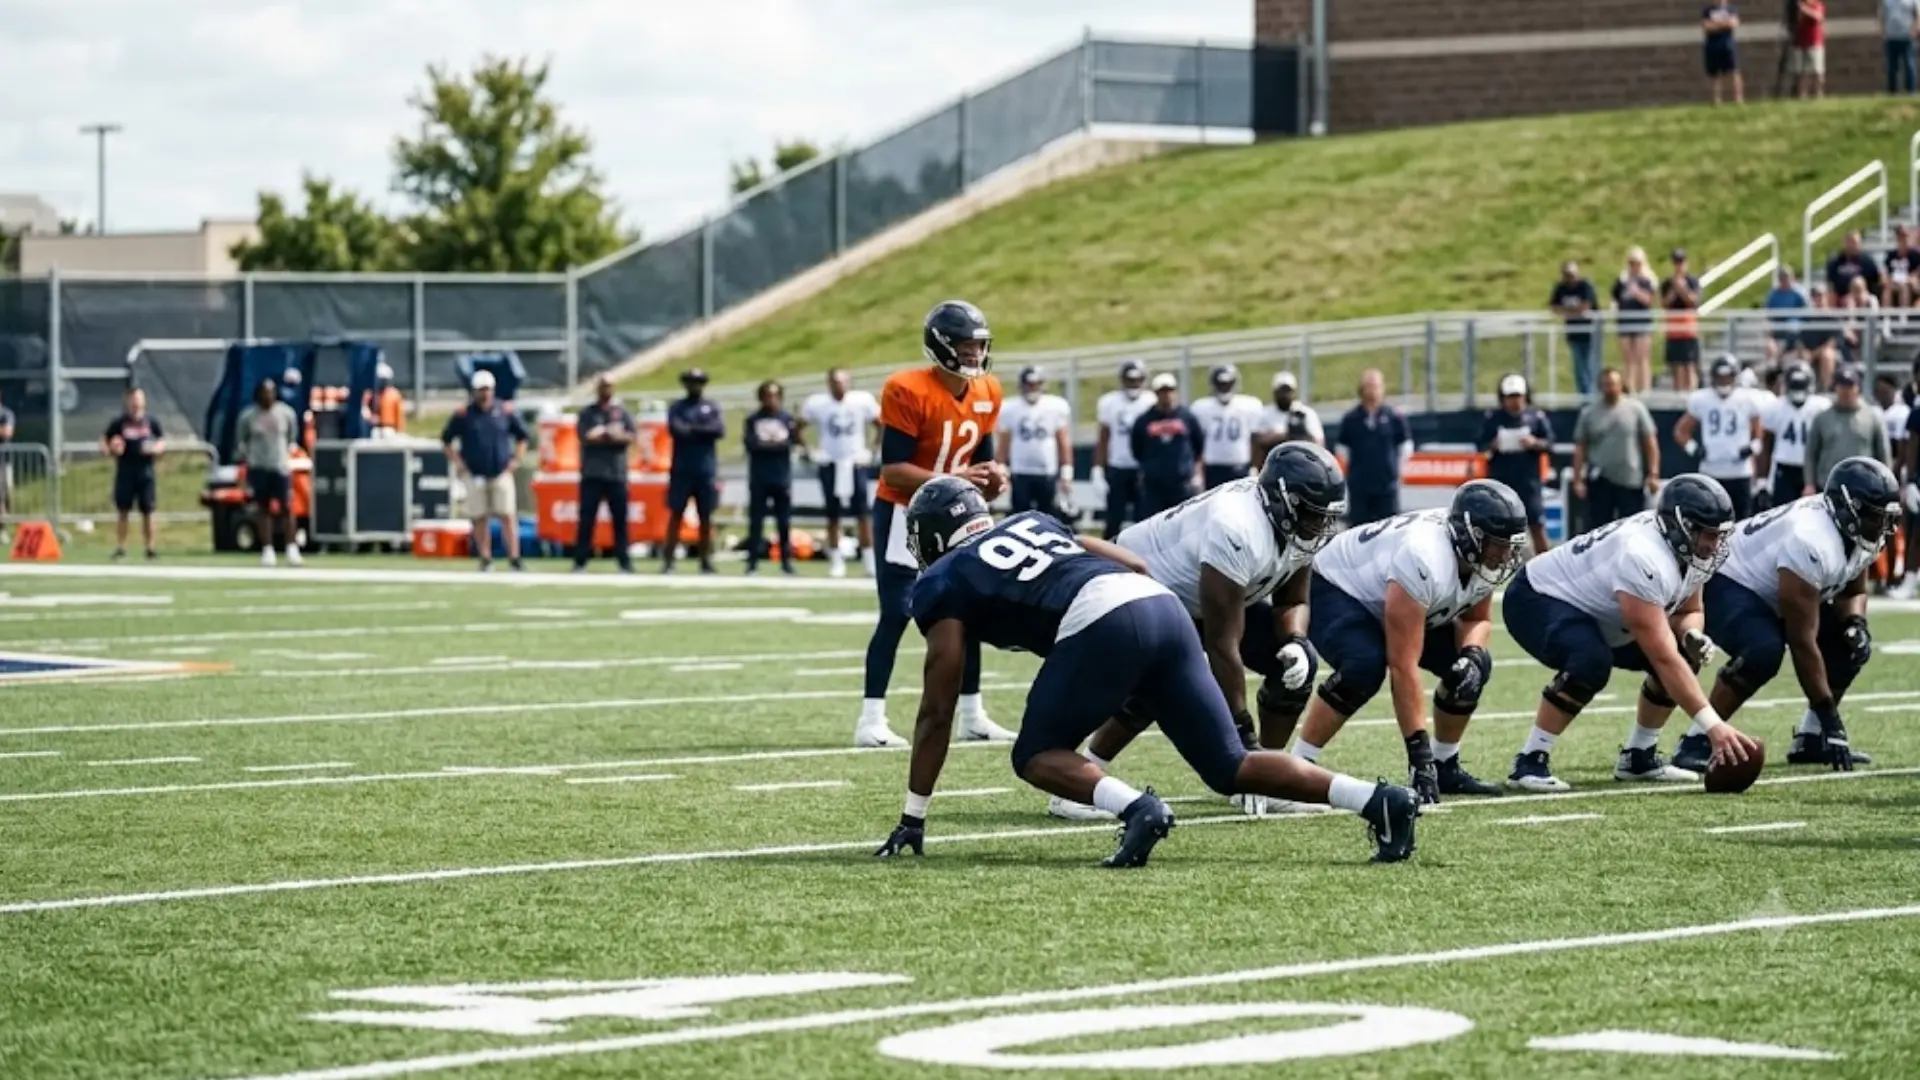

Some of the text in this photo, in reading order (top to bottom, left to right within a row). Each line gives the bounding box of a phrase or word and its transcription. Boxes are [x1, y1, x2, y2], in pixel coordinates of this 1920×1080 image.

[933, 419, 979, 475] 12
[1708, 408, 1738, 437] 93
[978, 518, 1087, 582] 95
